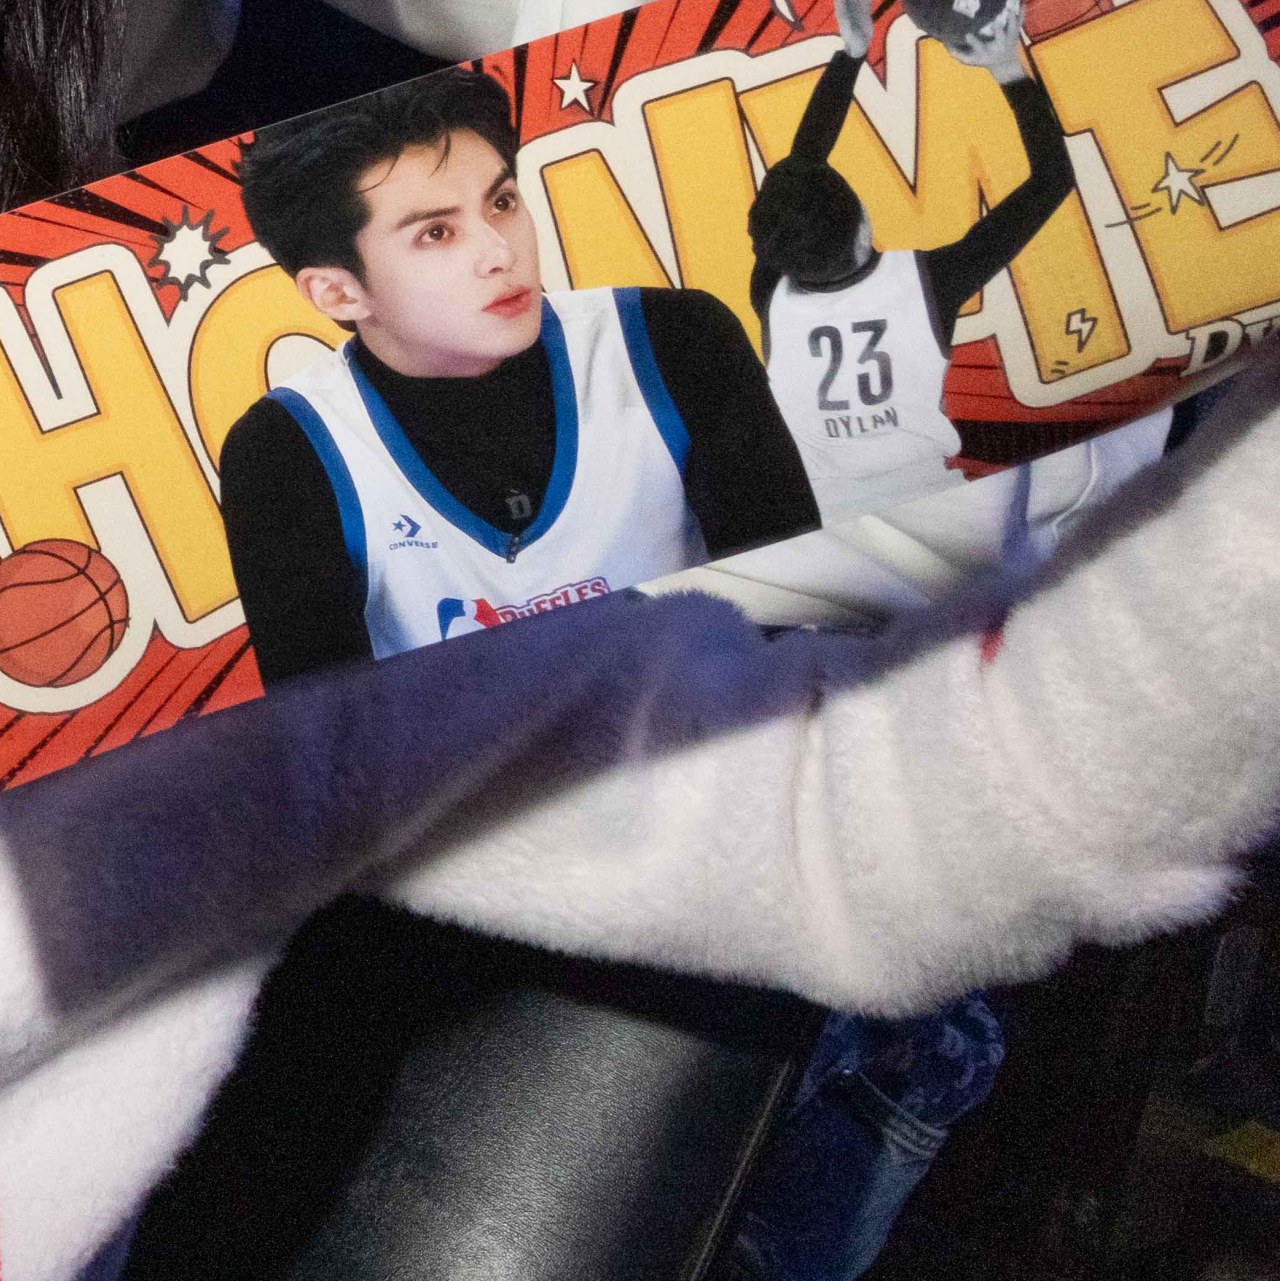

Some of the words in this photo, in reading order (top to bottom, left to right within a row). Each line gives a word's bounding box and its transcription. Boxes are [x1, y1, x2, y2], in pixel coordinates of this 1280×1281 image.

[808, 318, 893, 411] 23
[824, 407, 899, 438] DYLAN
[388, 539, 439, 551] CONVERSE
